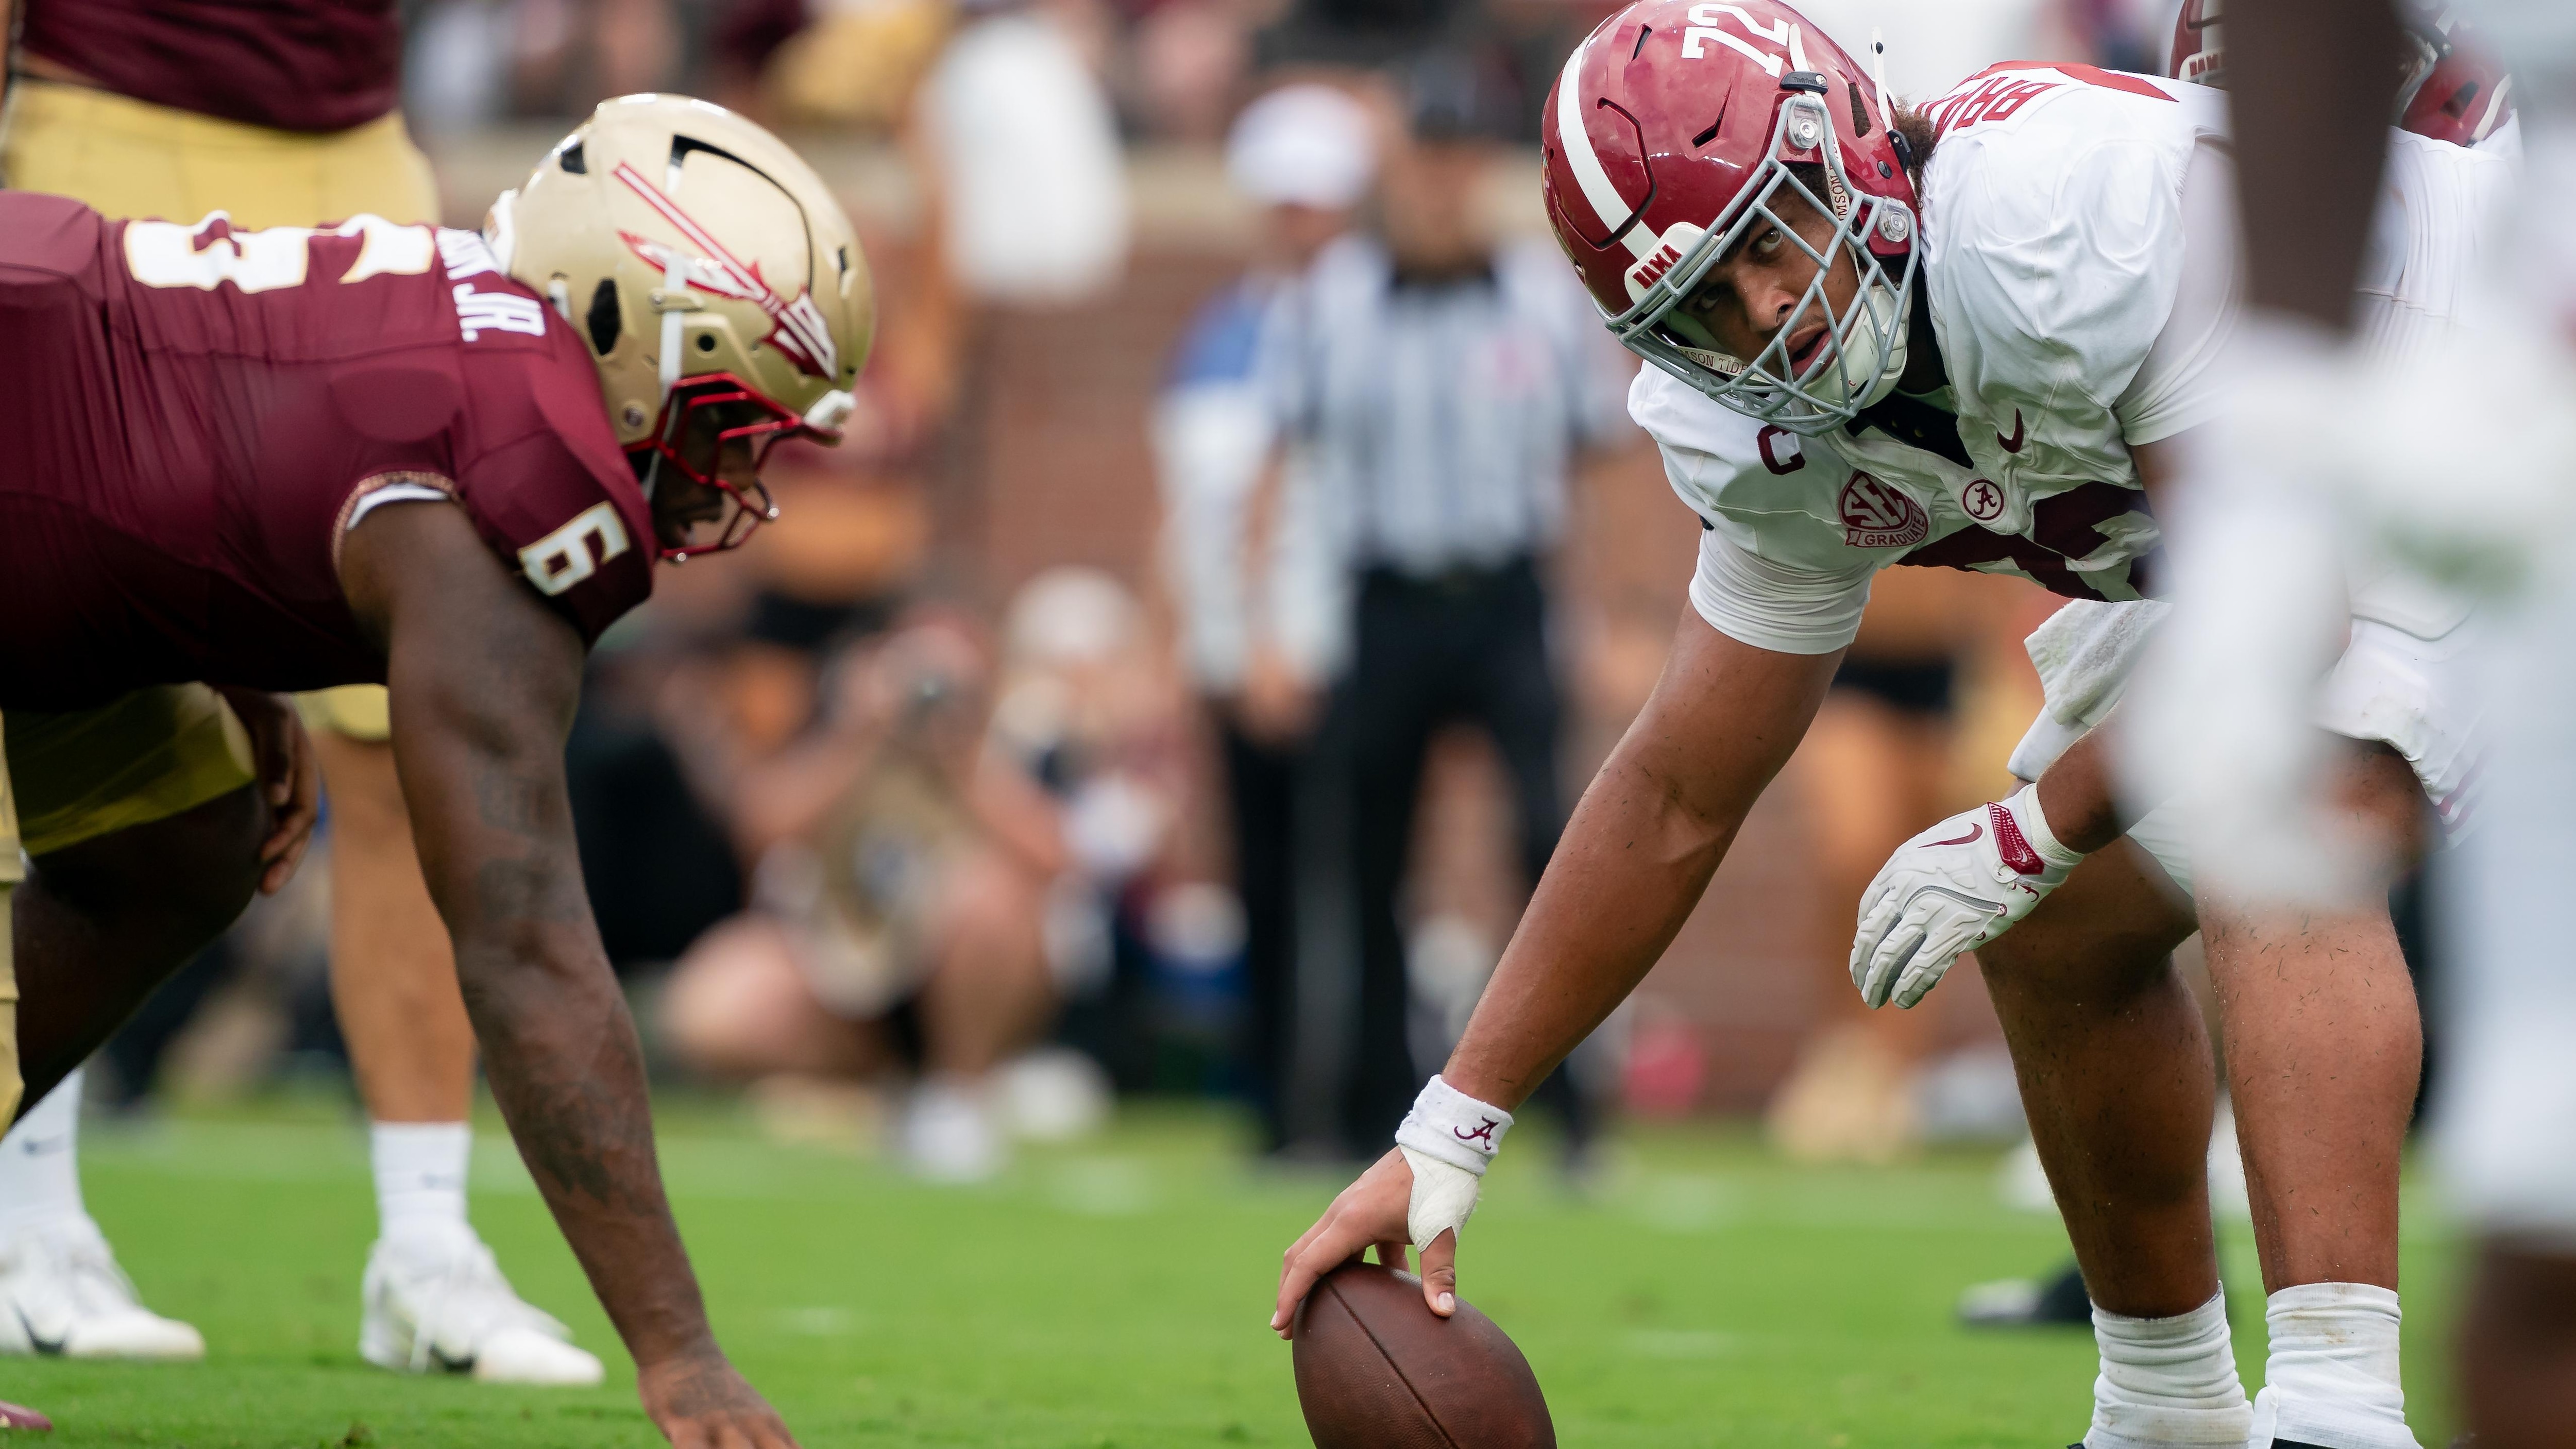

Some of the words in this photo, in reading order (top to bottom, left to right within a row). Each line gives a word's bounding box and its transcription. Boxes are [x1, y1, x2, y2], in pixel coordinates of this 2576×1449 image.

[1681, 3, 1790, 78] 72
[1829, 175, 1848, 221] MSON
[1632, 244, 1683, 290] BAMA
[452, 282, 546, 342] JR.
[1680, 349, 1714, 367] MSON
[1756, 424, 1806, 475] C
[1844, 474, 1906, 527] SEC
[1973, 484, 1997, 515] A
[517, 500, 631, 597] 6
[1864, 516, 1925, 545] GRADUATE
[1454, 1115, 1499, 1150] A
